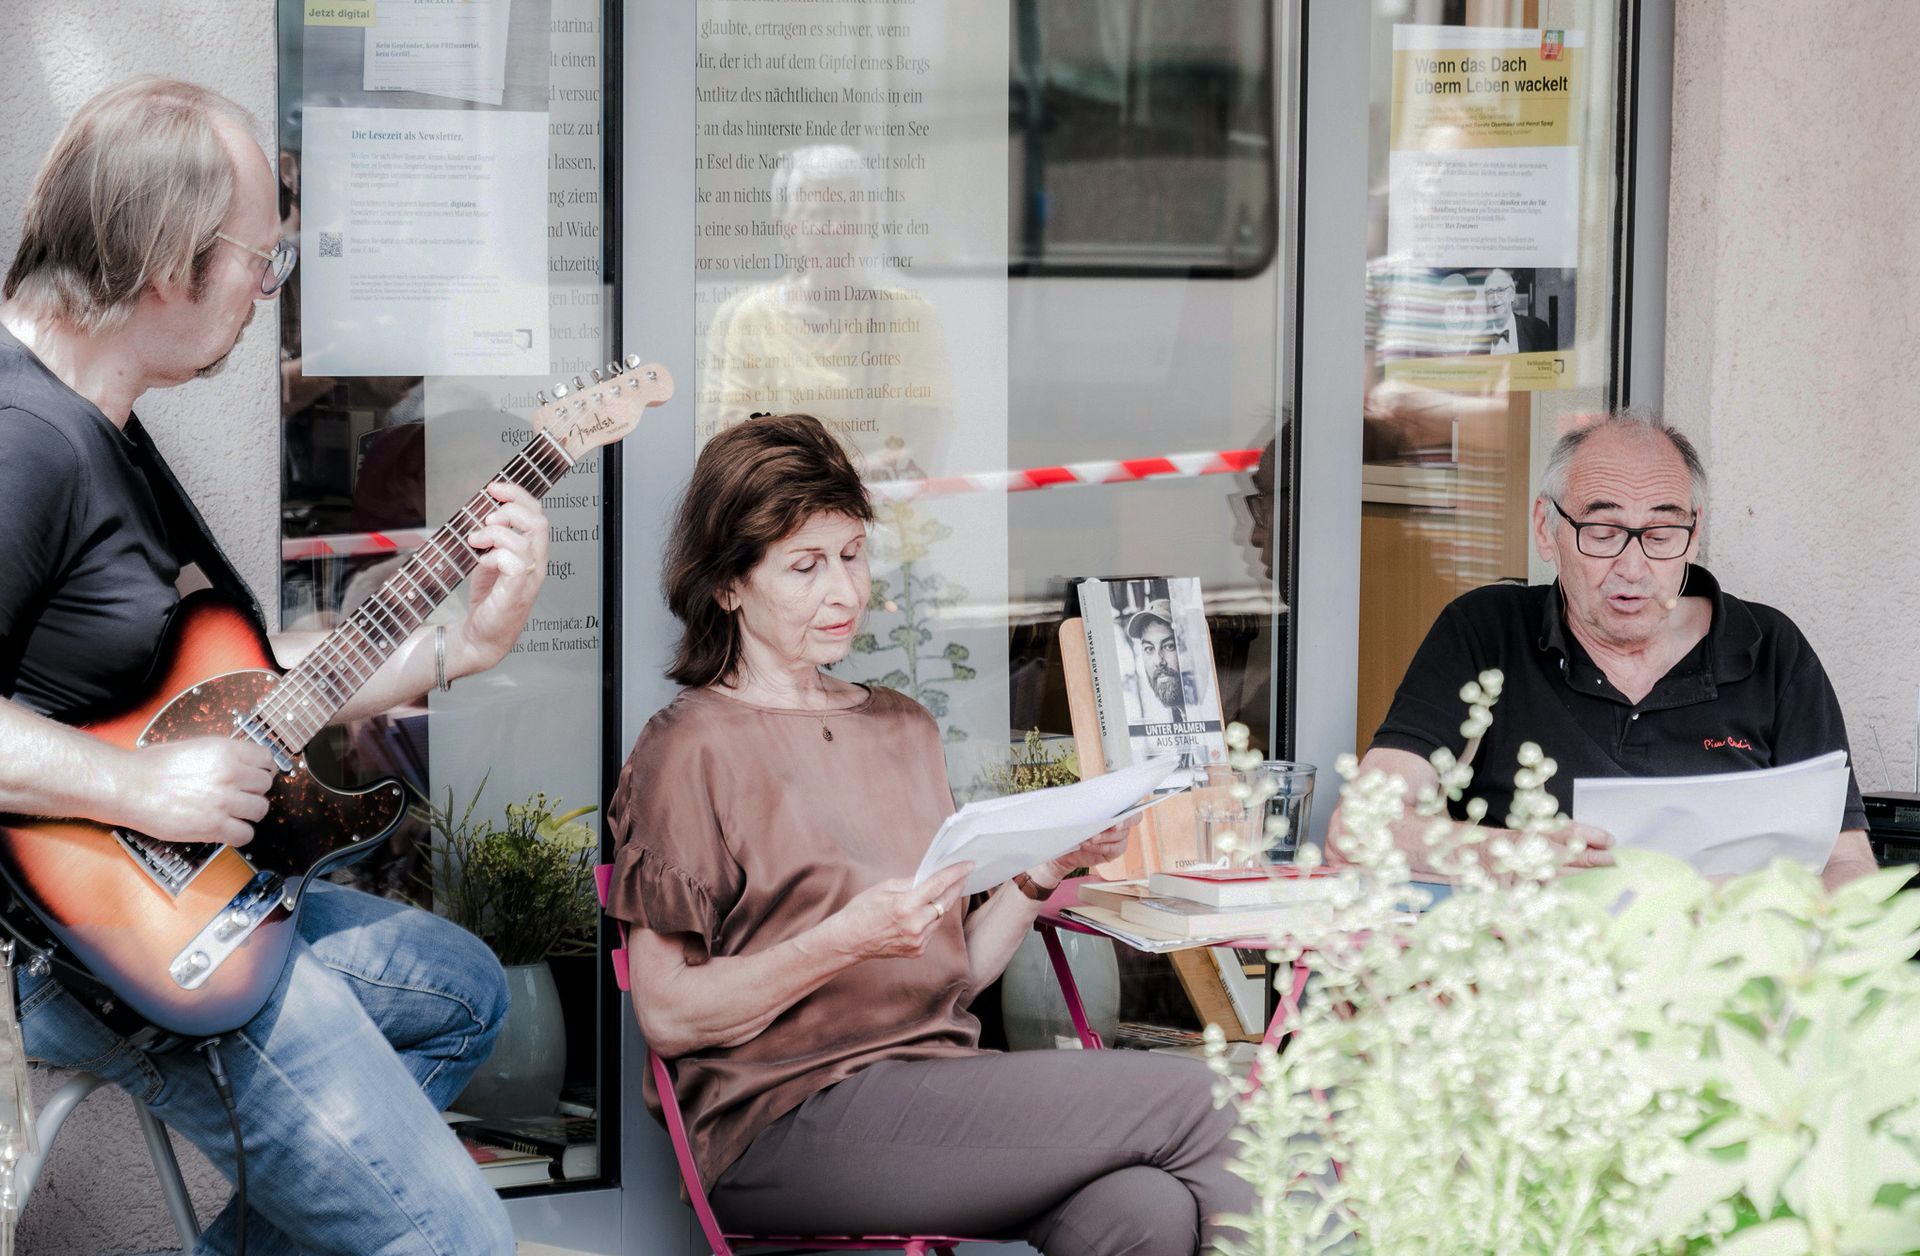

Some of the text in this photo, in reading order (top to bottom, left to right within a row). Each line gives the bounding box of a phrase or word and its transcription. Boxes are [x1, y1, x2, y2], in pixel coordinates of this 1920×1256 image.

[309, 8, 370, 20] Jetzt digital
[754, 21, 806, 40] ertragen
[810, 24, 823, 37] es
[877, 24, 910, 38] wenn
[561, 51, 596, 68] einen
[719, 52, 740, 70] der
[743, 52, 762, 70] ich
[766, 53, 786, 70] auf
[788, 53, 815, 70] dem
[819, 54, 857, 73] Gipfel
[860, 54, 893, 71] eines
[896, 54, 930, 75] Bergs
[1415, 56, 1527, 74] Wenn das Dach
[1415, 75, 1568, 95] überm Leben wackelt
[740, 86, 761, 103] des
[765, 86, 838, 104] nächtlichen
[843, 86, 885, 104] Monds
[888, 87, 900, 103] in
[903, 87, 923, 103] ein
[352, 130, 367, 140] Die
[369, 130, 402, 140] Lesezeit
[404, 130, 416, 141] als
[577, 123, 593, 136] zu
[703, 122, 719, 136] an
[722, 120, 743, 136] das
[746, 120, 802, 137] hinterste
[806, 120, 837, 137] Ende
[840, 120, 861, 137] der
[864, 121, 905, 137] weiten
[908, 120, 930, 137] See
[554, 153, 596, 171] lassen,
[706, 153, 732, 169] Esel
[735, 153, 755, 169] die
[862, 153, 890, 170] steht
[892, 153, 926, 170] solch
[549, 188, 598, 208] ng ziem
[715, 189, 731, 203] an
[734, 187, 772, 203] nichts
[775, 186, 846, 204] Blibendes,
[849, 189, 865, 203] an
[867, 187, 906, 203] nichts
[548, 221, 599, 238] nd Wide
[705, 219, 929, 240] eine so häufige Erscheinung wie den
[715, 257, 729, 270] so
[732, 252, 770, 270] vielen
[774, 252, 823, 273] Dingen,
[826, 252, 854, 269] auch
[858, 255, 878, 269] vor
[881, 252, 913, 271] jener
[824, 286, 840, 302] im
[844, 318, 863, 334] ich
[866, 317, 886, 334] ihn
[889, 317, 920, 334] nicht
[743, 350, 761, 369] die
[860, 349, 902, 367] Gottes
[818, 382, 863, 400] können
[866, 382, 902, 400] außer
[905, 381, 932, 399] dem
[569, 412, 615, 446] Fender
[548, 525, 588, 543] licken
[527, 640, 549, 653] dem
[1086, 630, 1095, 656] STAHL
[1094, 677, 1102, 708] PALMEN
[1145, 721, 1206, 736] UNTER PALMEN
[1157, 735, 1199, 747] AUS STAHL
